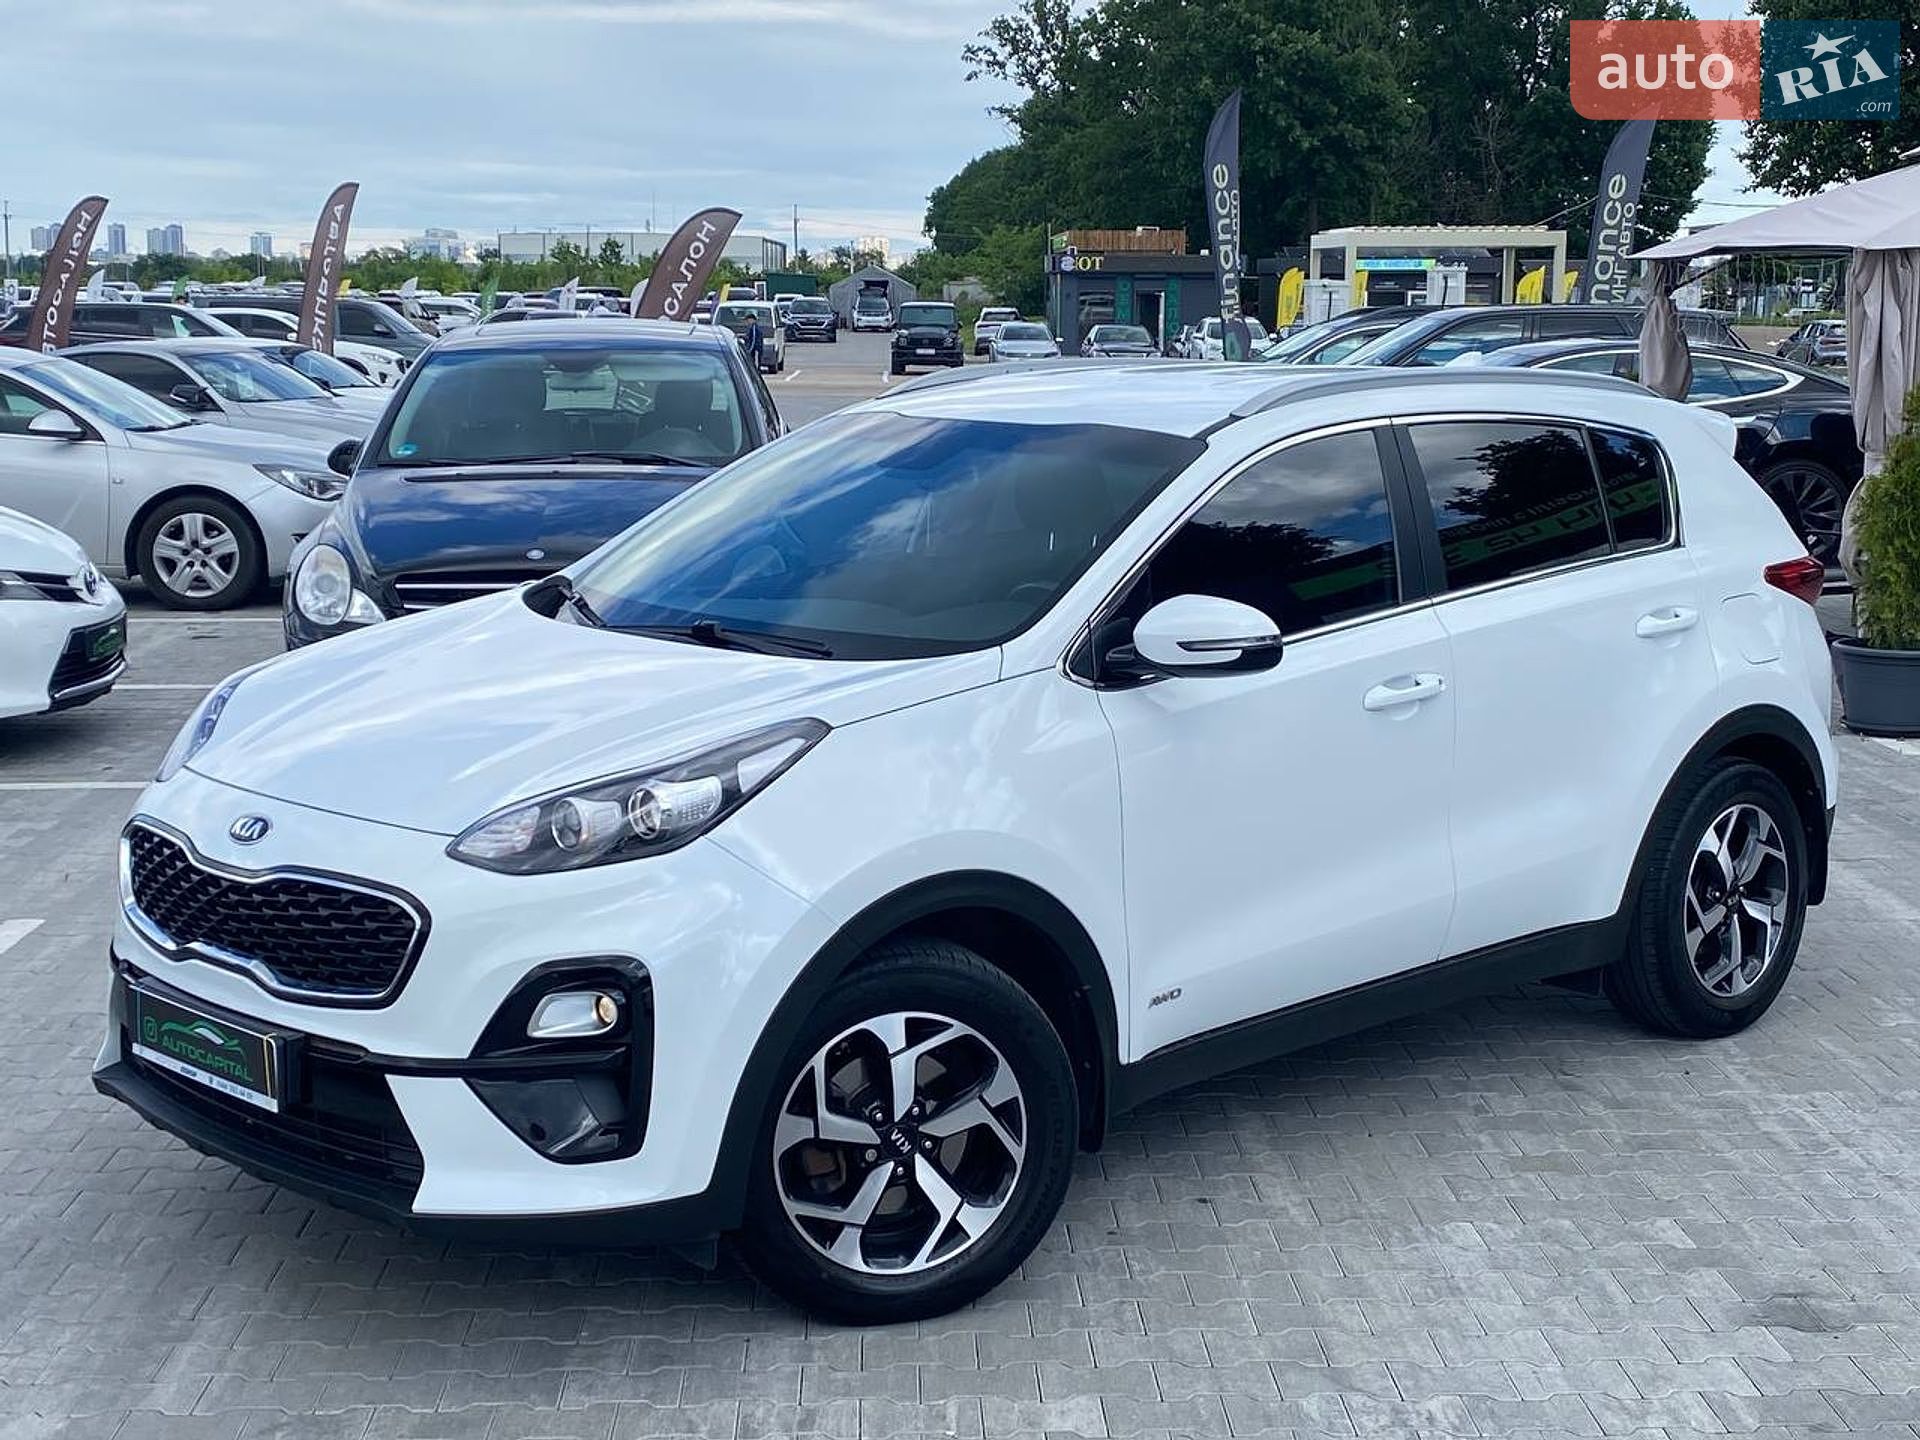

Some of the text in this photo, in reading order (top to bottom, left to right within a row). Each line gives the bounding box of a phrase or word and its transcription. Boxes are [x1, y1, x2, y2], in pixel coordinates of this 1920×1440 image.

[1590, 173, 1627, 304] nance
[1617, 202, 1635, 259] АВТО
[658, 219, 717, 320] САЛОН
[1148, 987, 1182, 1009] AWD
[161, 1034, 254, 1082] AUTOCAPITAL
[891, 1128, 912, 1154] KIA
